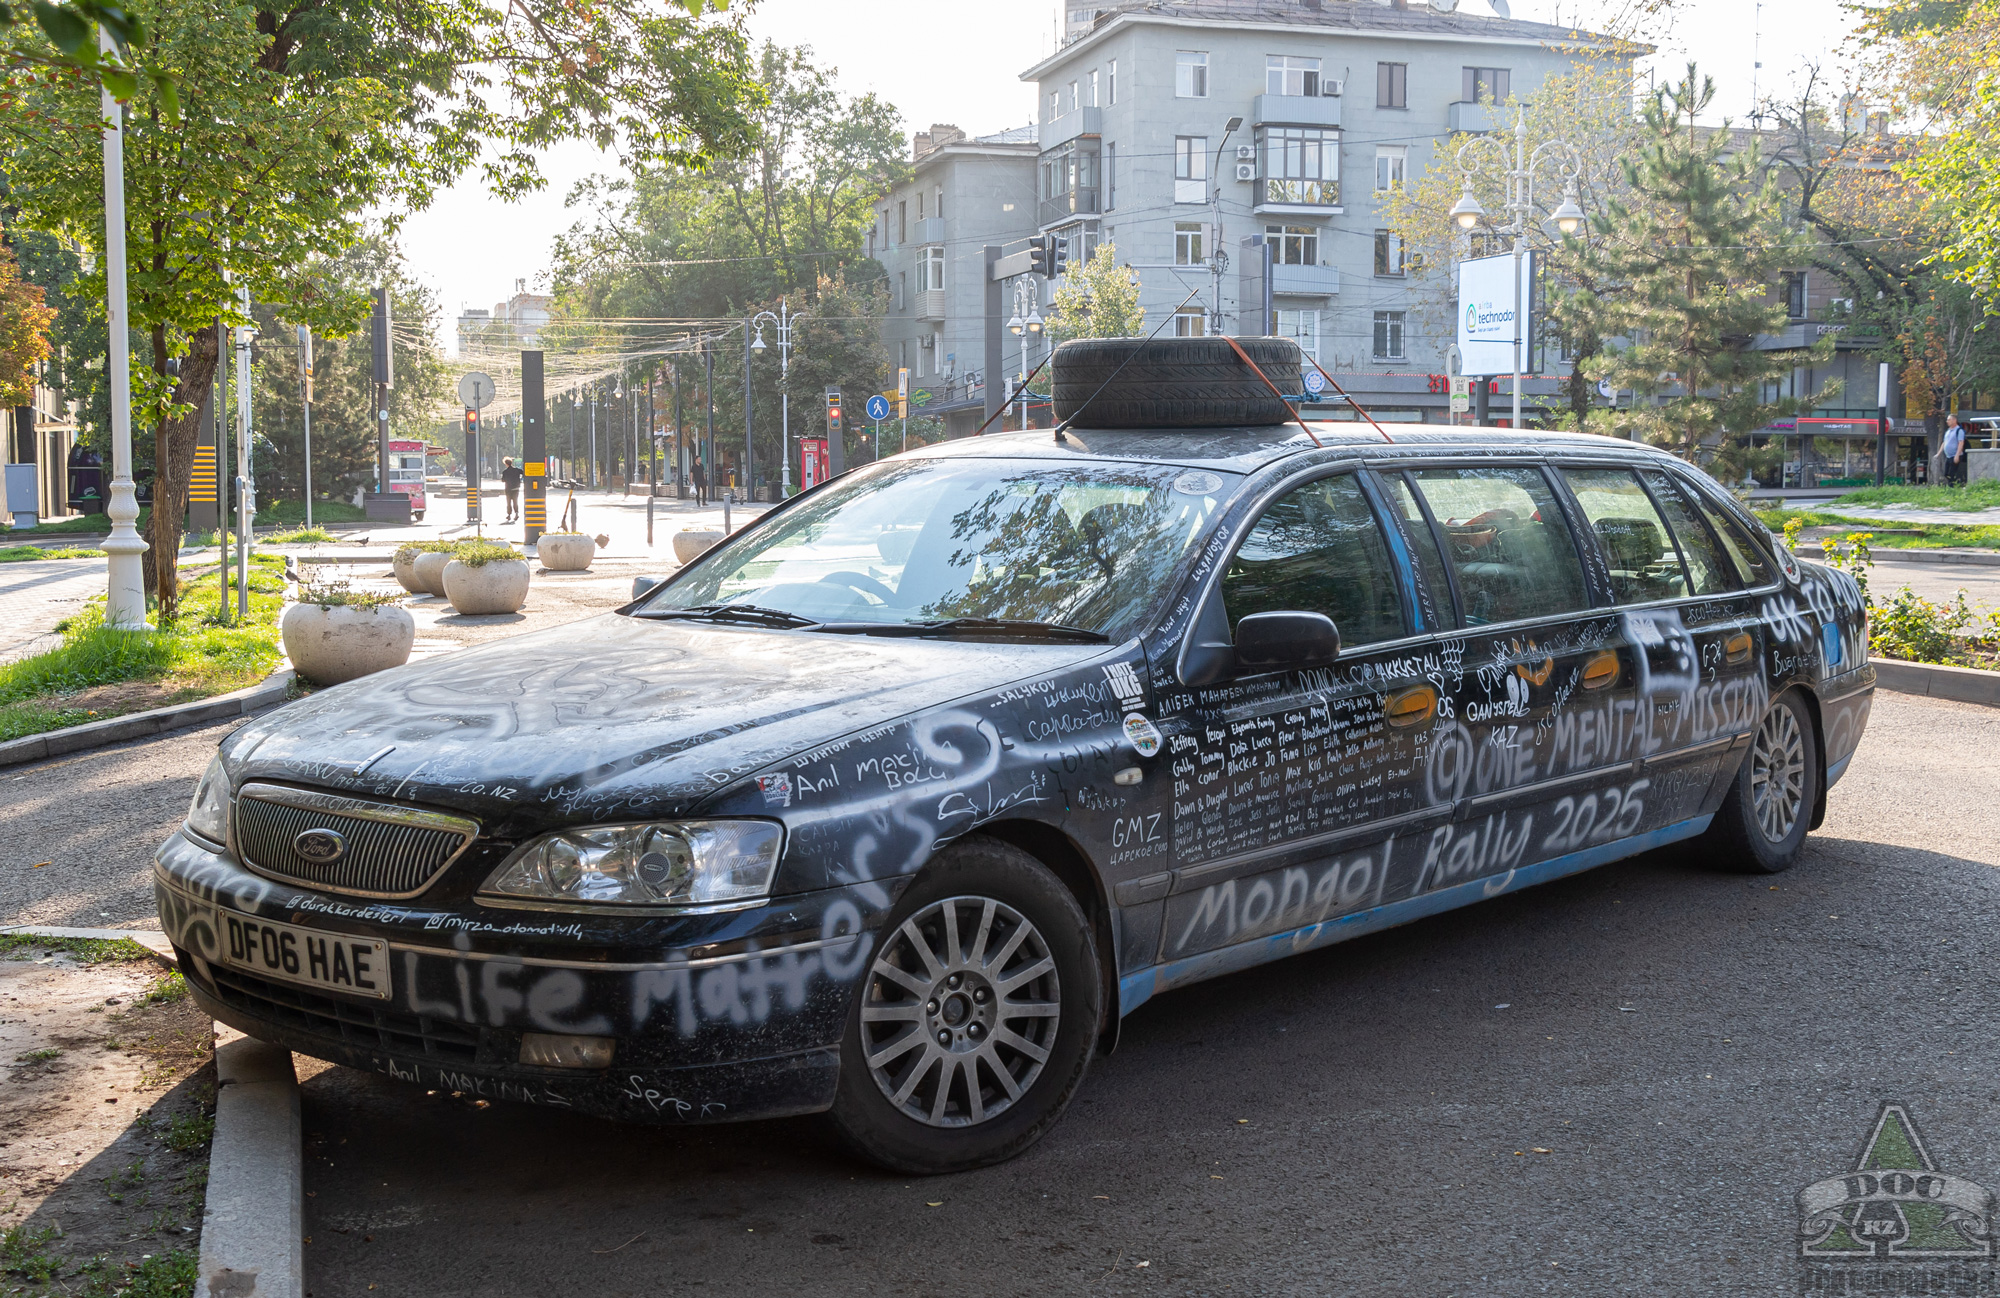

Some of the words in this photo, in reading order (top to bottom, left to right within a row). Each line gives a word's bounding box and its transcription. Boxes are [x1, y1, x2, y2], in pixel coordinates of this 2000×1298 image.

[1101, 666, 1111, 679] I
[1107, 661, 1136, 678] HATE
[1109, 674, 1144, 699] UKG
[1169, 734, 1199, 755] Jeffrey
[1205, 725, 1226, 746] Fergus
[1547, 695, 1664, 776] MENTAL
[1672, 672, 1769, 744] MISSION
[1172, 756, 1195, 778] Gabby
[1200, 751, 1225, 771] Tommy
[1251, 736, 1272, 751] Lucca
[1278, 730, 1295, 747] Fleur
[1174, 779, 1190, 798] Ella
[1227, 755, 1258, 777] Blackie
[1265, 750, 1276, 768] Jo
[1323, 733, 1341, 750] Edith
[1174, 801, 1196, 820] Dawn
[1197, 797, 1204, 812] &
[1285, 766, 1301, 781] Max
[1345, 743, 1360, 758] Jesse
[303, 835, 333, 857] Ford
[1112, 811, 1161, 848] GMZ
[1174, 821, 1194, 837] Helen
[1177, 833, 1394, 950] Mongol
[1414, 806, 1531, 897] Rally
[1542, 778, 1652, 852] 2025
[227, 916, 300, 975] DF06
[306, 935, 376, 990] HAE
